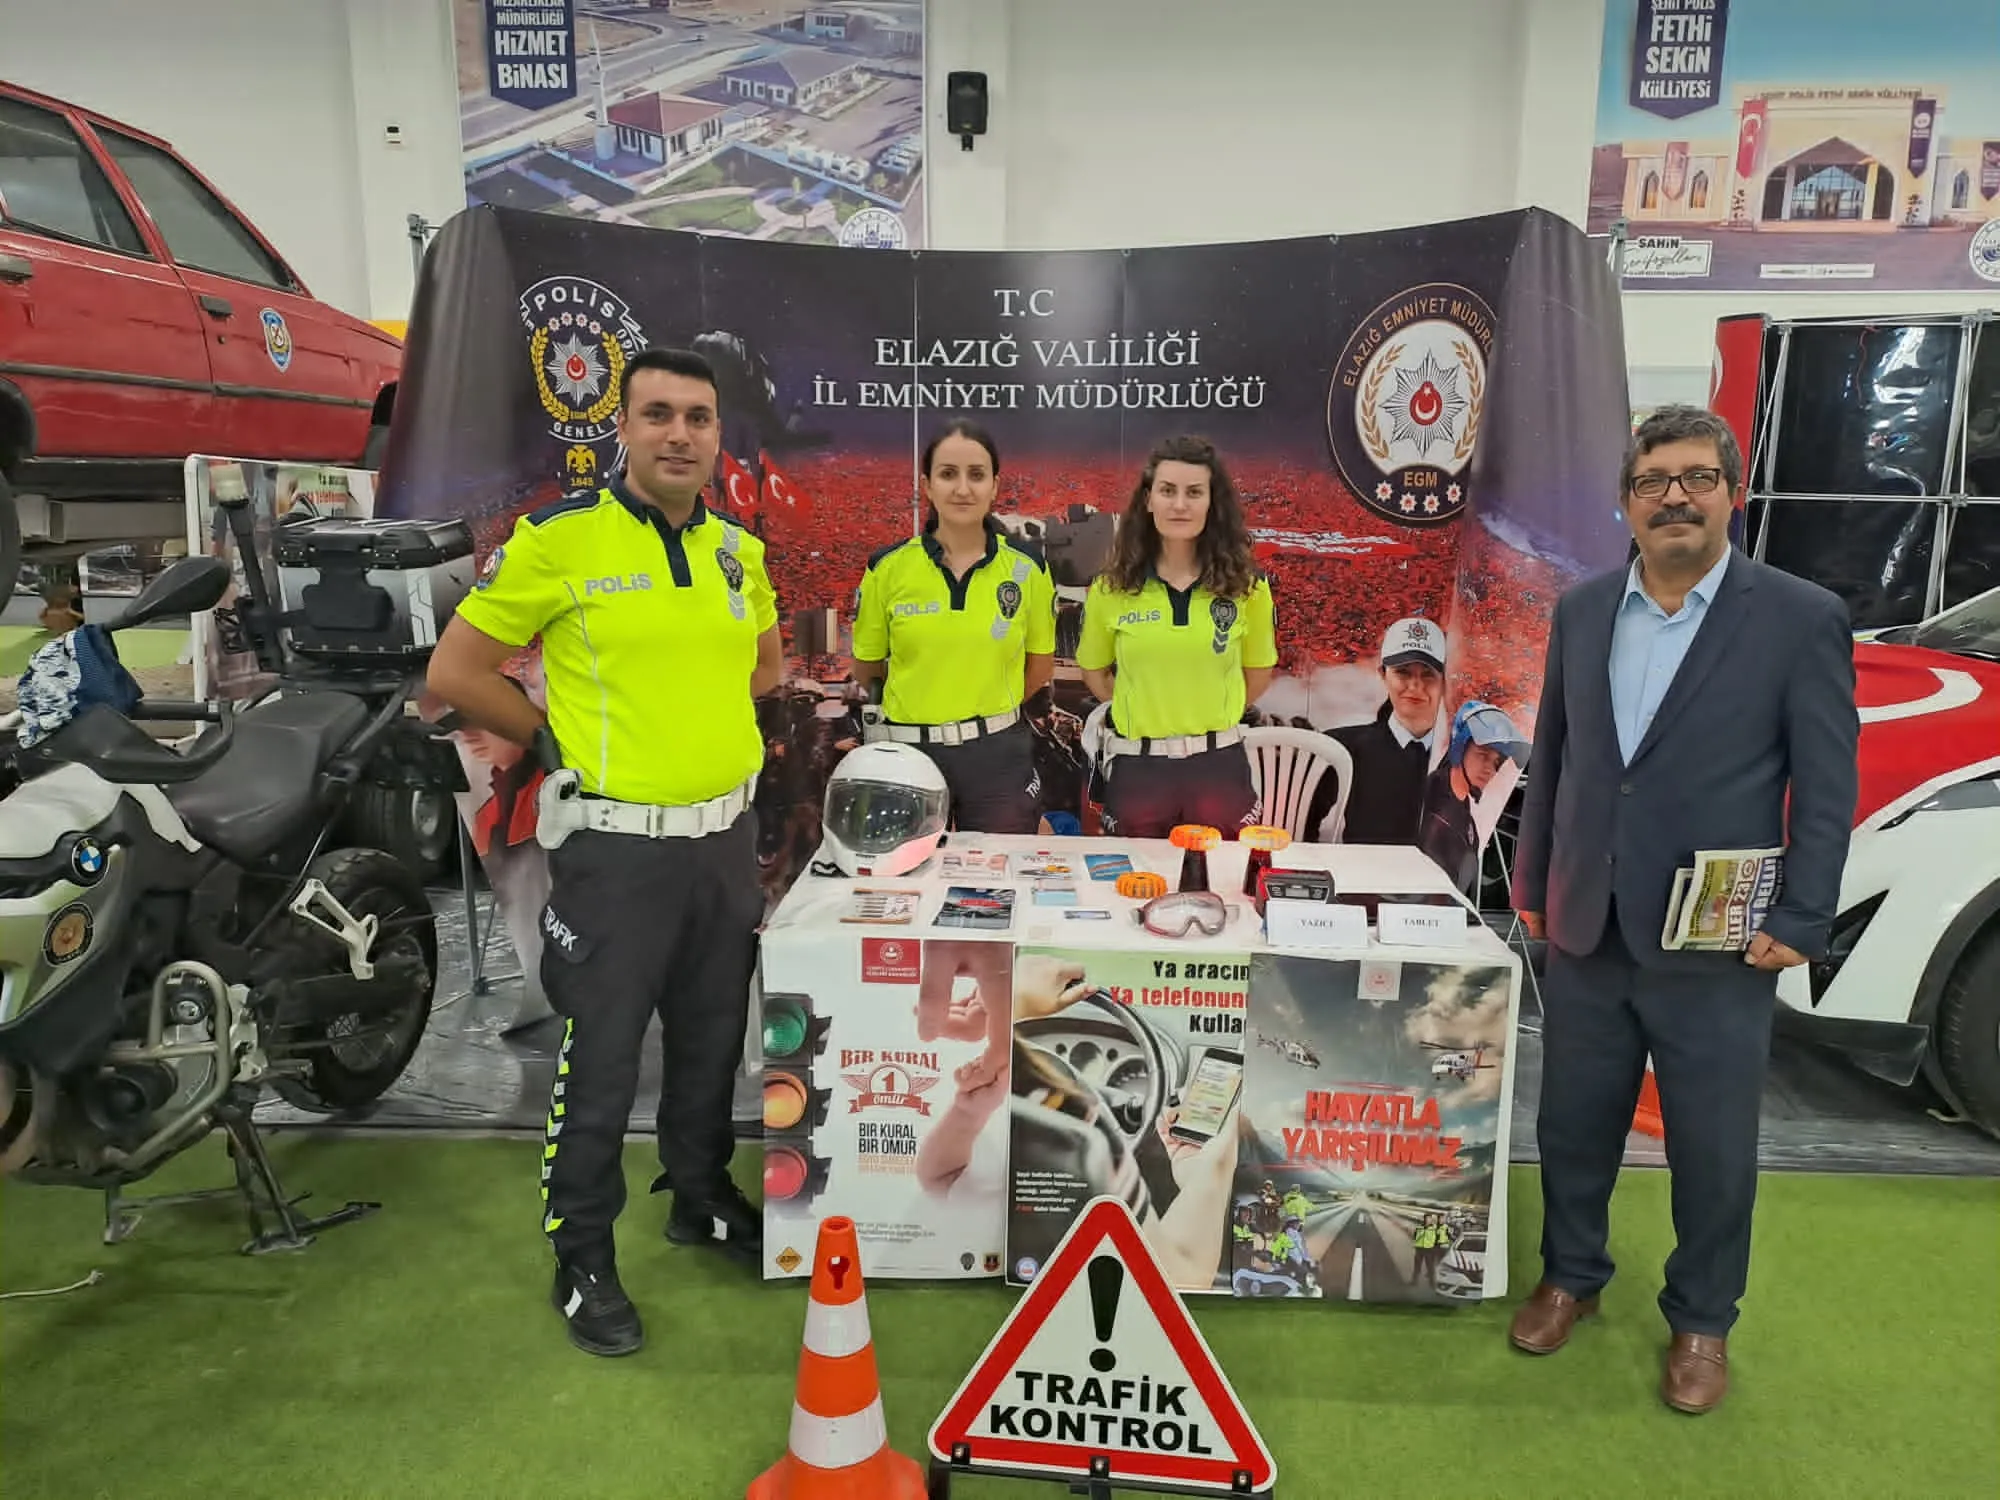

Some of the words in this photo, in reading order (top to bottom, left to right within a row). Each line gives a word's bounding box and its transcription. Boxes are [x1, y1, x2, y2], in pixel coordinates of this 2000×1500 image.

[534, 285, 616, 318] POLİS
[994, 289, 1055, 317] T.C
[1382, 296, 1447, 332] EMNİYET
[874, 333, 1020, 367] ELAZIĞ
[1032, 330, 1201, 367] VALİLİĞİ
[813, 374, 847, 407] İL
[857, 377, 1024, 408] EMNİYET
[1035, 375, 1266, 408] MÜDÜRLÜĞÜ
[553, 421, 606, 438] GENEL
[1404, 471, 1438, 488] EGM
[585, 573, 652, 596] POLİS
[1118, 609, 1161, 626] POLİS
[1404, 918, 1441, 928] TABLET
[1153, 960, 1177, 978] Ya
[1110, 986, 1134, 1006] Ya
[1141, 986, 1248, 1009] telefonun
[881, 1051, 940, 1072] KURAL
[881, 1071, 895, 1092] 1
[1305, 1090, 1441, 1130] HAYATLA
[880, 1123, 918, 1139] KURAL
[1282, 1127, 1463, 1172] YARIŞILMAZ
[1015, 1371, 1187, 1417] TRAFİK
[990, 1405, 1212, 1454] KONTROL
